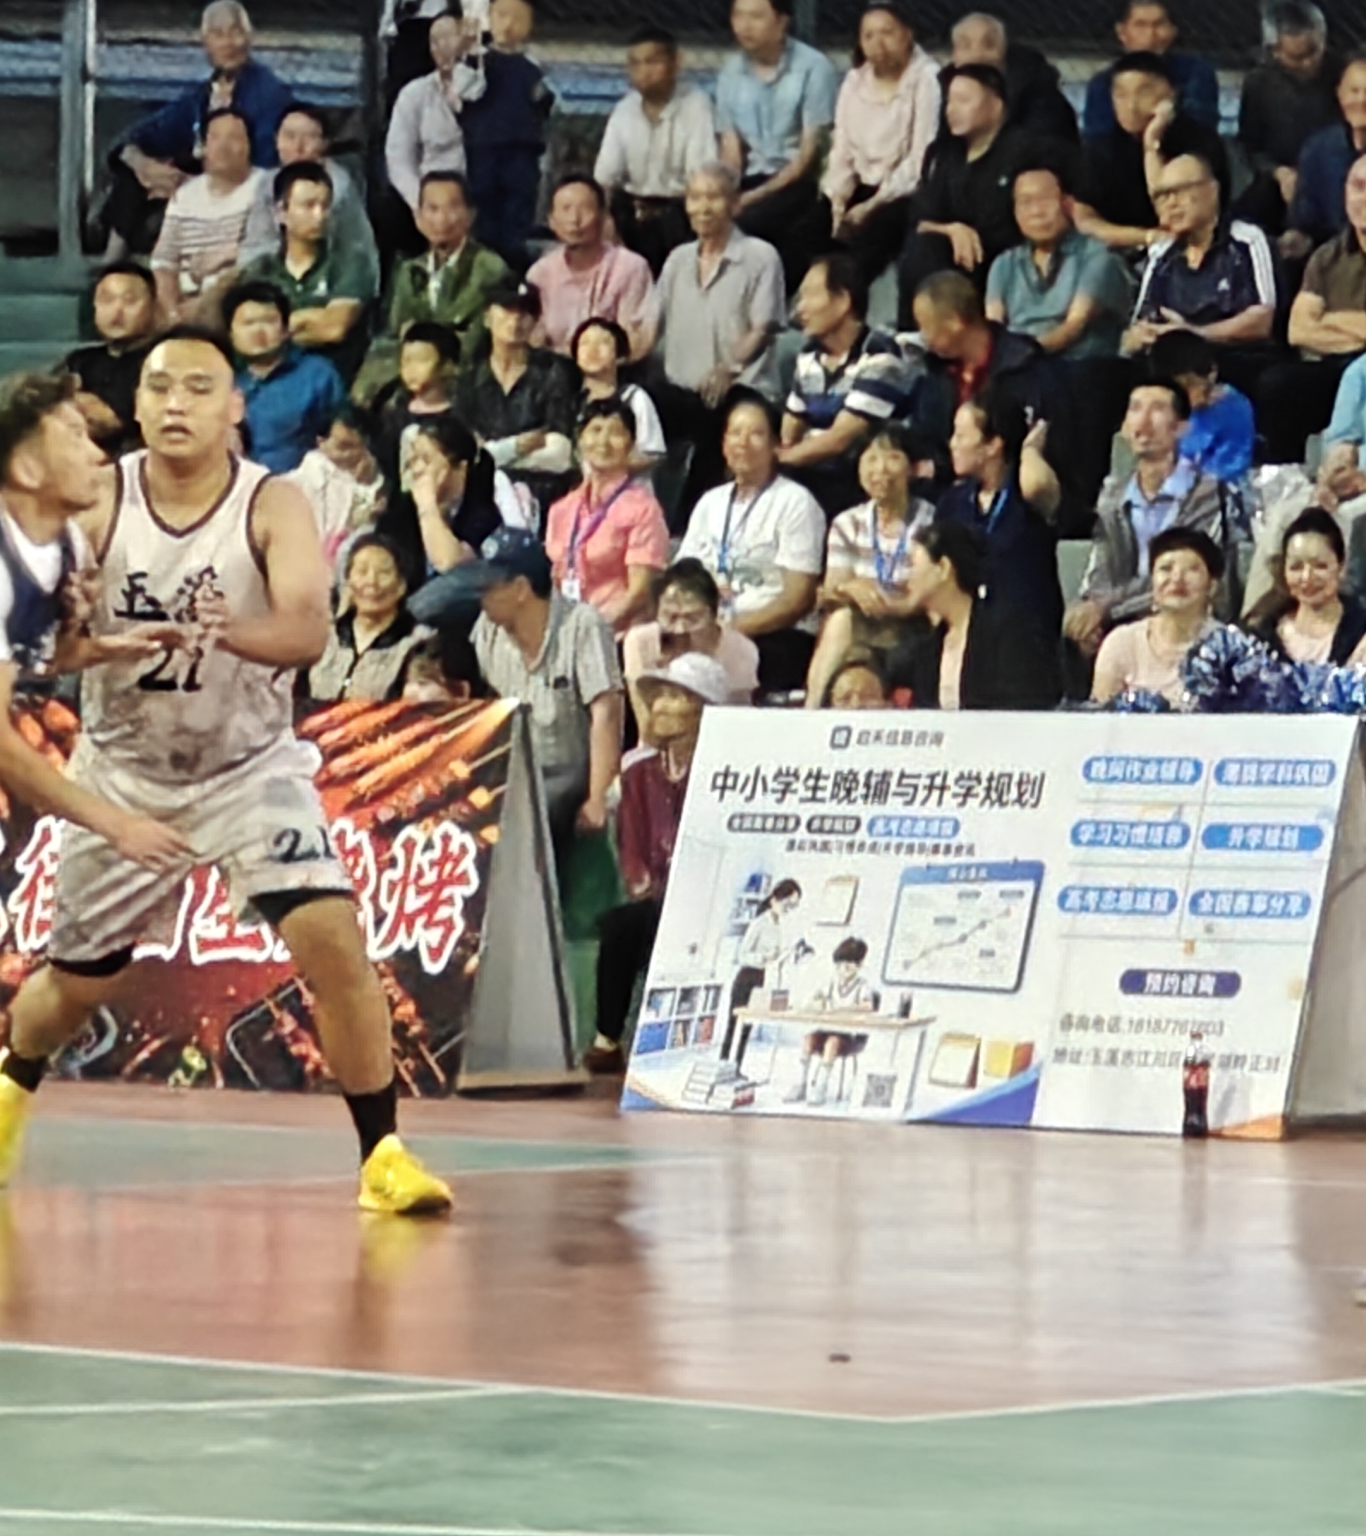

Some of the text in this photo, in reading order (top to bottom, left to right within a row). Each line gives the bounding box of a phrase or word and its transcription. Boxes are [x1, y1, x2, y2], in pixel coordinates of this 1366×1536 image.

[709, 764, 1046, 809] 中小学生晚辅与升学规划
